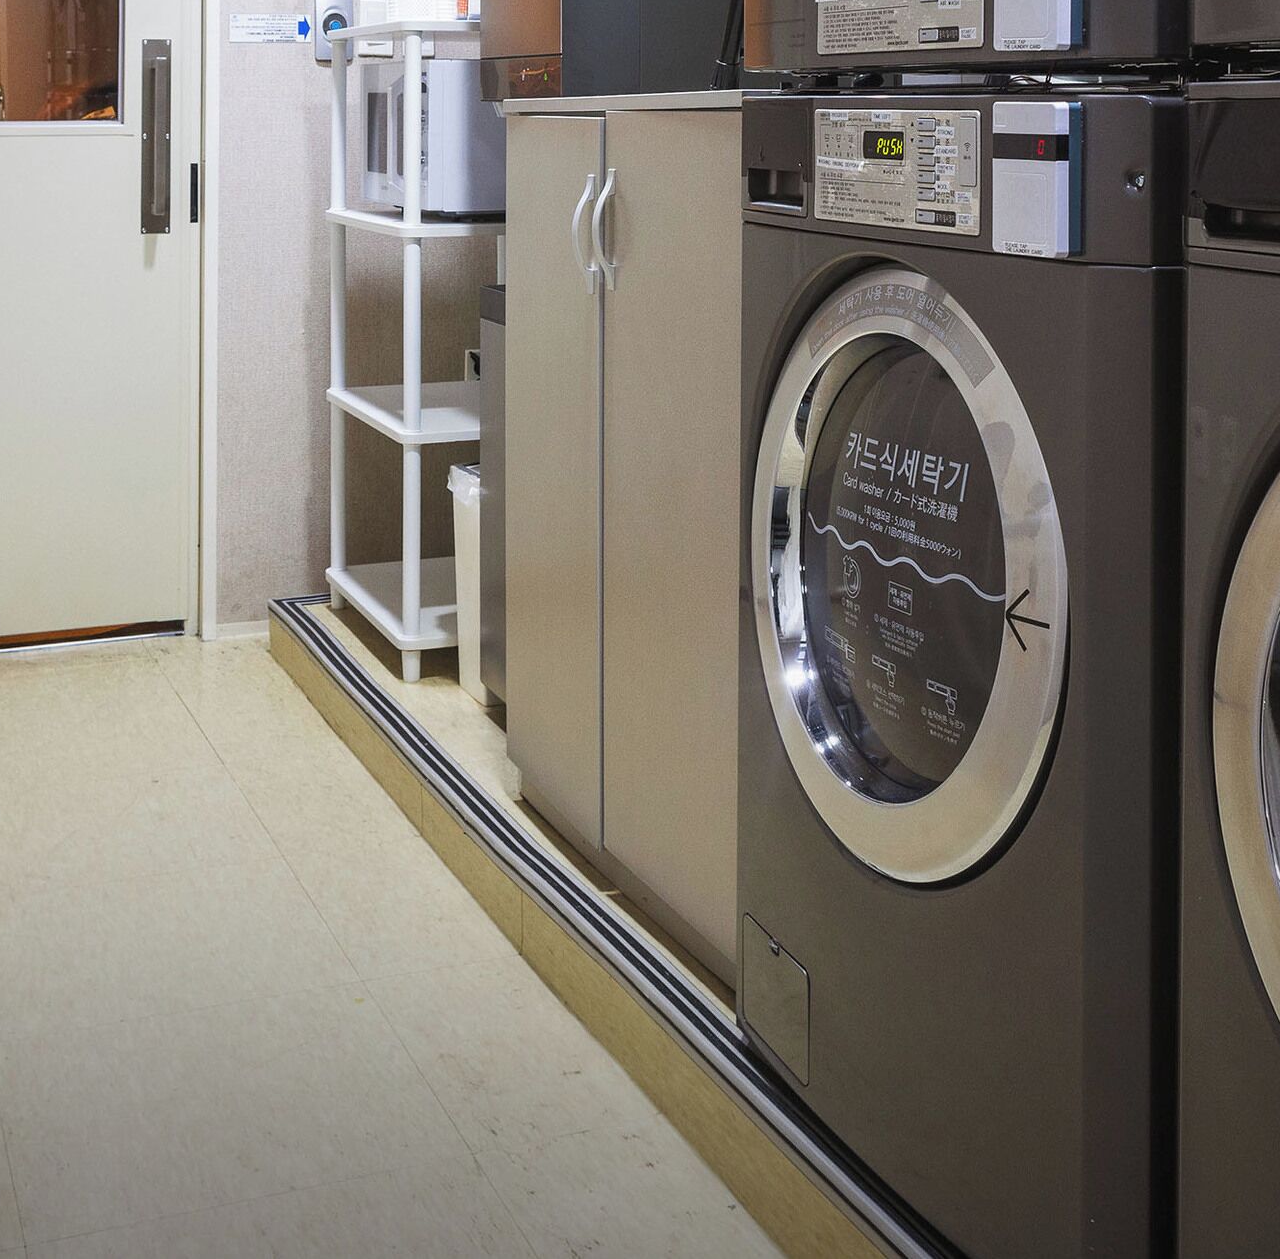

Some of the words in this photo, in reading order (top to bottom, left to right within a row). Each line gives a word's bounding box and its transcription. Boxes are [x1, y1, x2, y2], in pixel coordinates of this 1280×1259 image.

[876, 138, 904, 155] PUSH
[845, 431, 970, 502] 카드식세탁기
[842, 471, 858, 489] Card
[859, 480, 884, 499] washer
